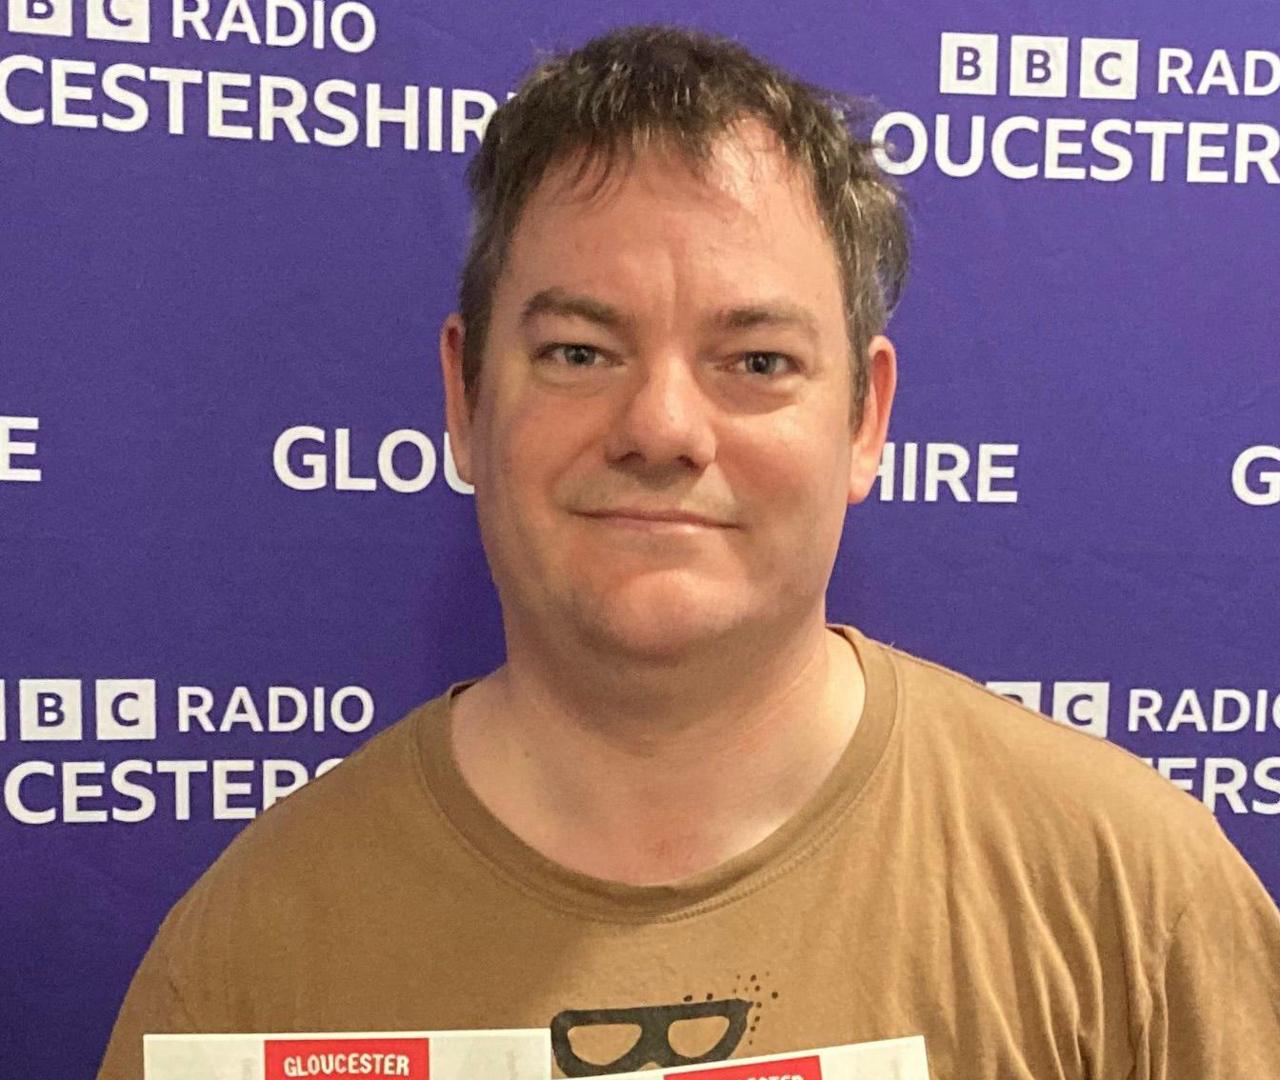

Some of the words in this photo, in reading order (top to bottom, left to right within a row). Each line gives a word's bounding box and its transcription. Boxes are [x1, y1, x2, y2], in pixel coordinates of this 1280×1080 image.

[172, 0, 376, 53] RADIO
[954, 43, 1126, 89] BBC
[178, 686, 374, 733] RADIO
[283, 1053, 410, 1078] GLOUCESTER
